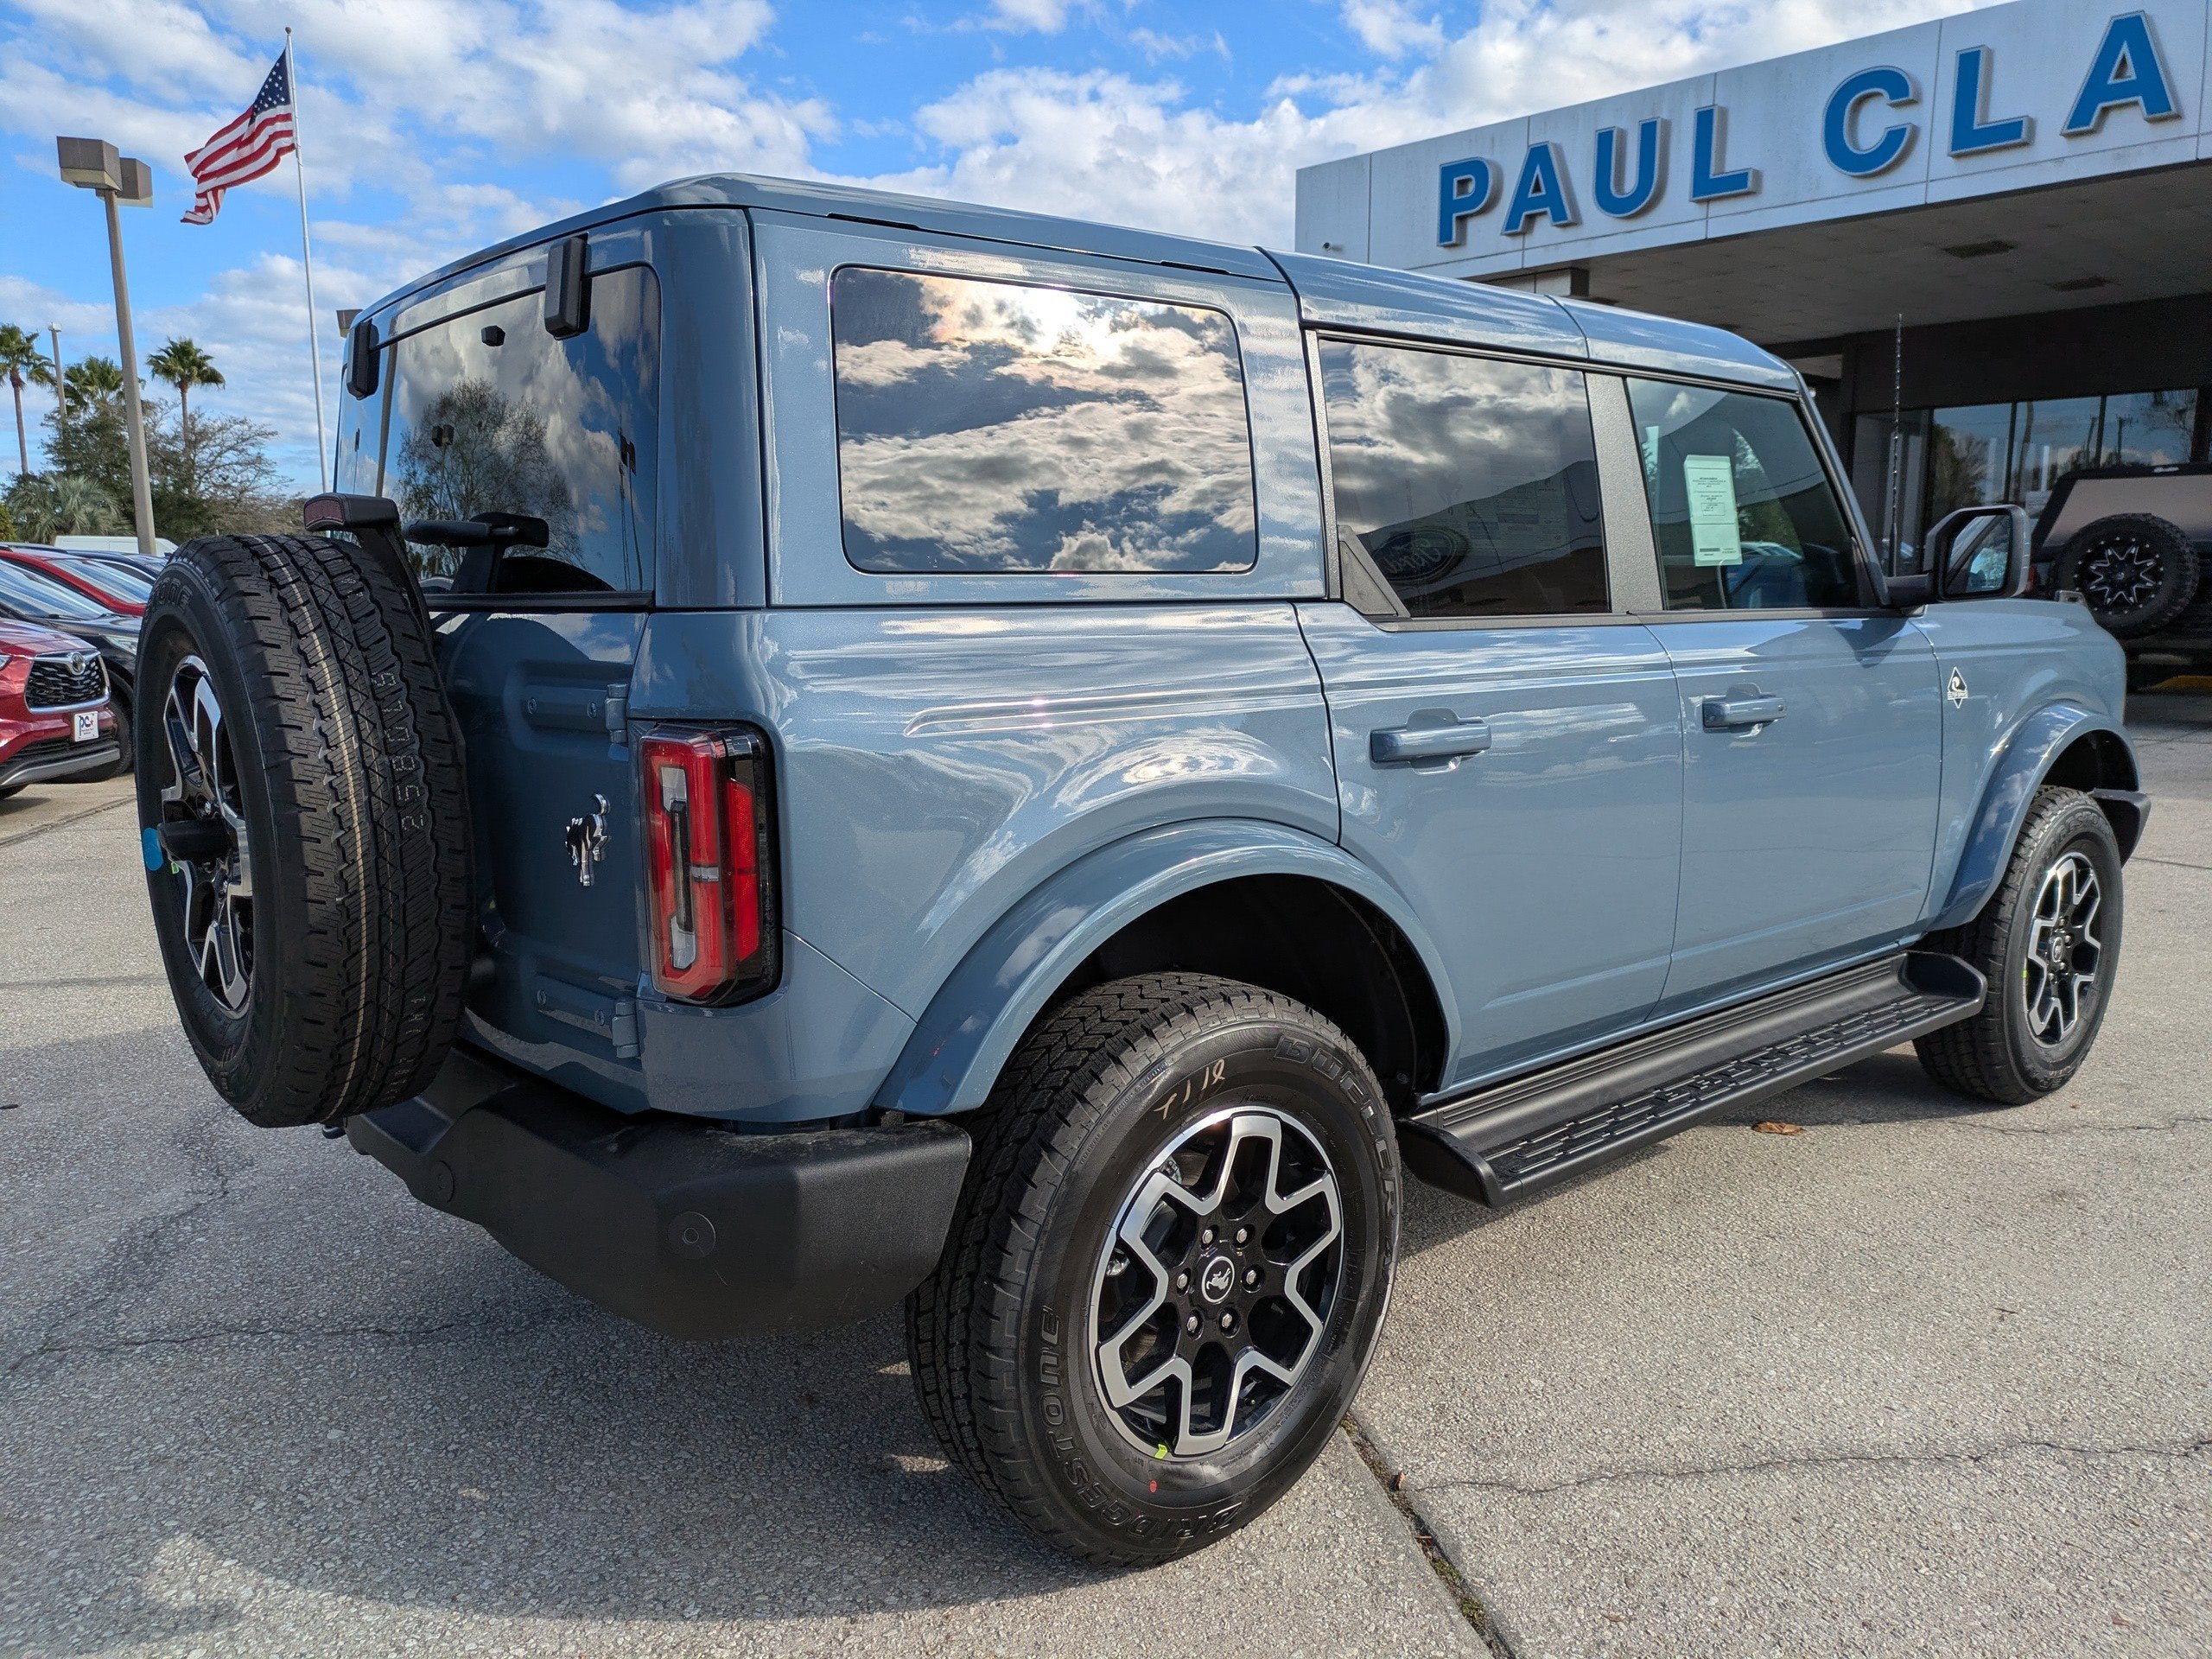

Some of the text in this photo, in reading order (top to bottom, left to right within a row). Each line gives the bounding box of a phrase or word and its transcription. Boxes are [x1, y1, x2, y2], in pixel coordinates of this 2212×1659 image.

[1437, 10, 2182, 248] PAUL CLA
[1274, 1036, 1401, 1217] DUELER
[1039, 1305, 1243, 1539] BRIDGESTONE
